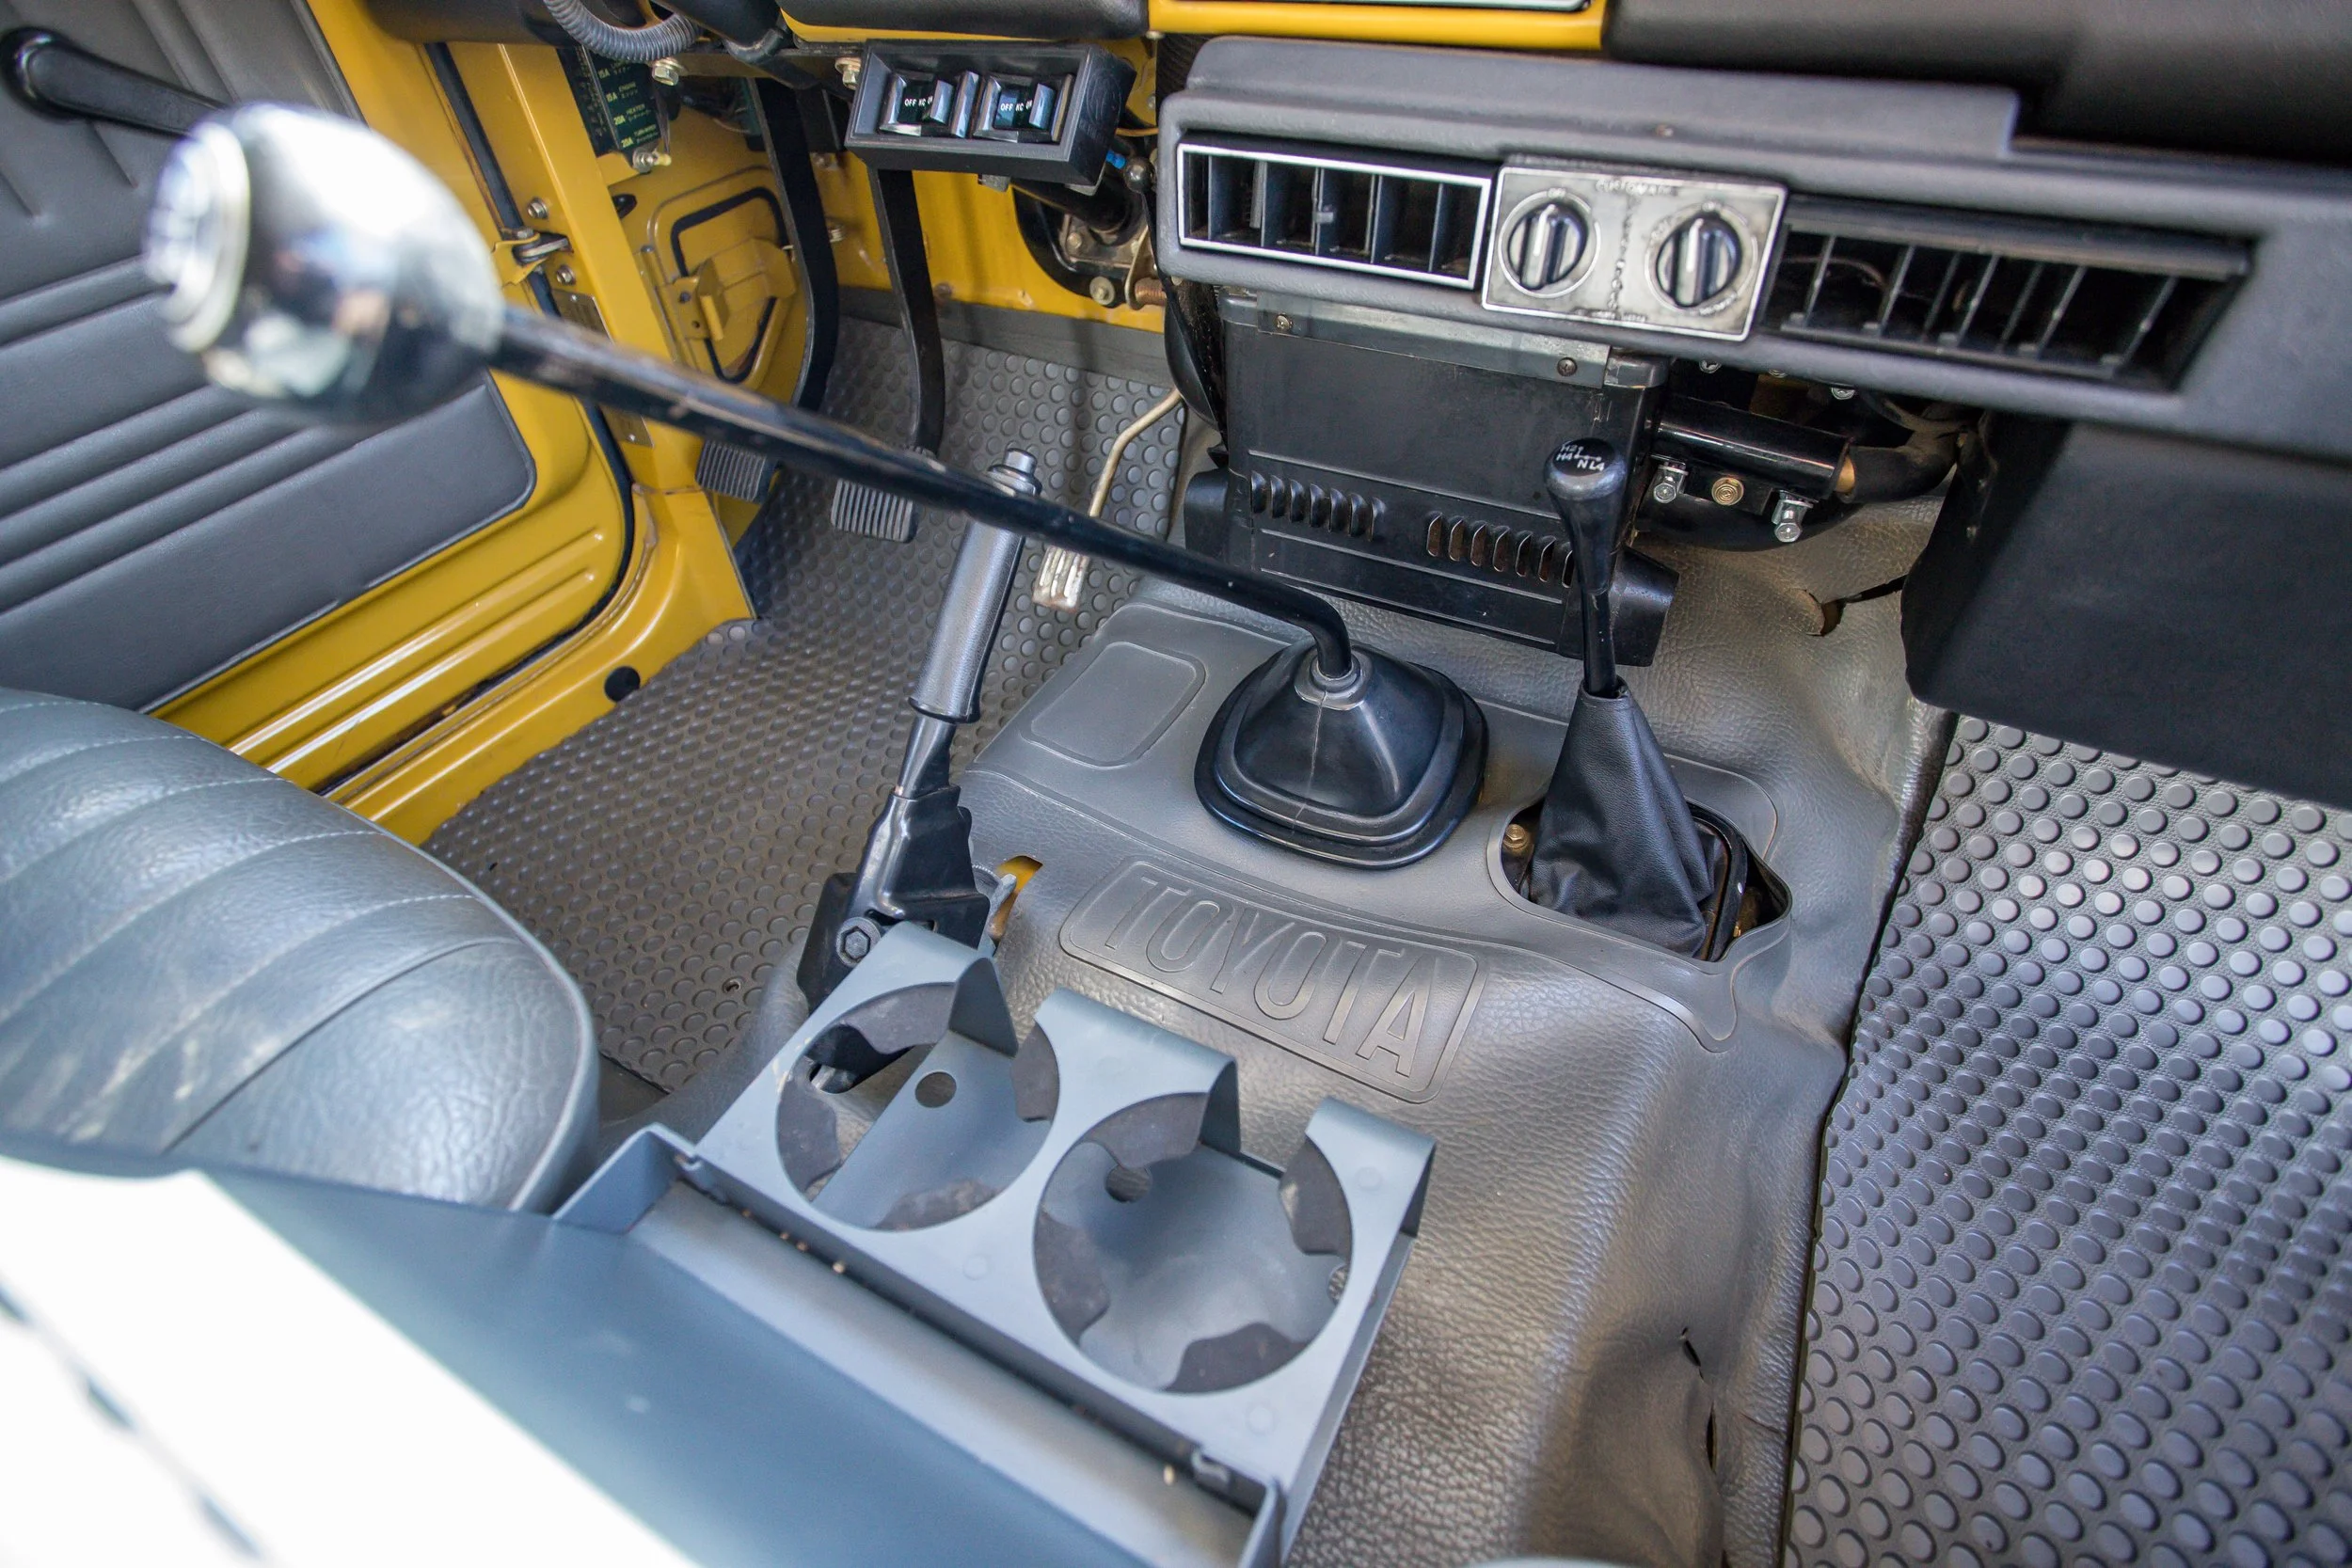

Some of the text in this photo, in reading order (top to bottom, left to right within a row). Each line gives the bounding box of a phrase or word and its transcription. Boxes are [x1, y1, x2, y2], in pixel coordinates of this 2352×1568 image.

[904, 98, 917, 107] OFF
[1000, 103, 1014, 111] OFF
[1015, 103, 1025, 112] KC
[1556, 452, 1572, 461] H4
[1577, 459, 1587, 469] N
[1589, 462, 1605, 471] L4
[1104, 877, 1437, 1078] TOYOTA
